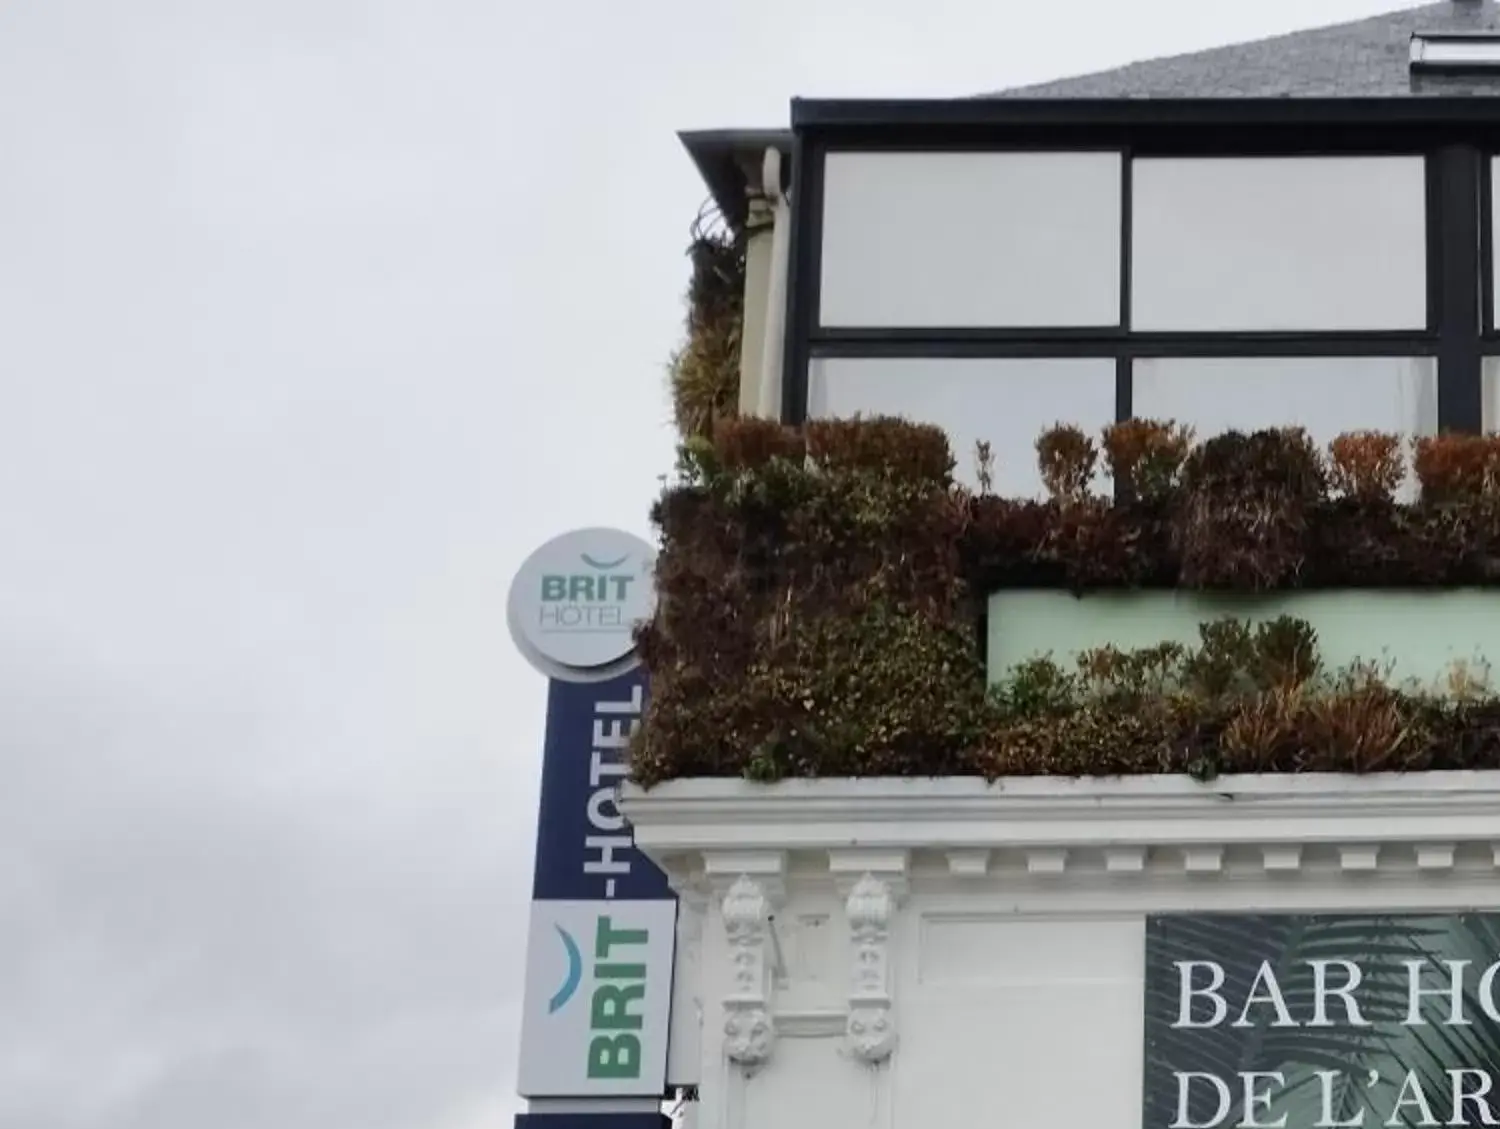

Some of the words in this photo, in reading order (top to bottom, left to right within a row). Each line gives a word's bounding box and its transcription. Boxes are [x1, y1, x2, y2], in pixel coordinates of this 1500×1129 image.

[541, 575, 634, 602] BRIT
[586, 915, 649, 1079] BRIT
[1170, 960, 1371, 1029] BAR
[1168, 1071, 1288, 1129] DE
